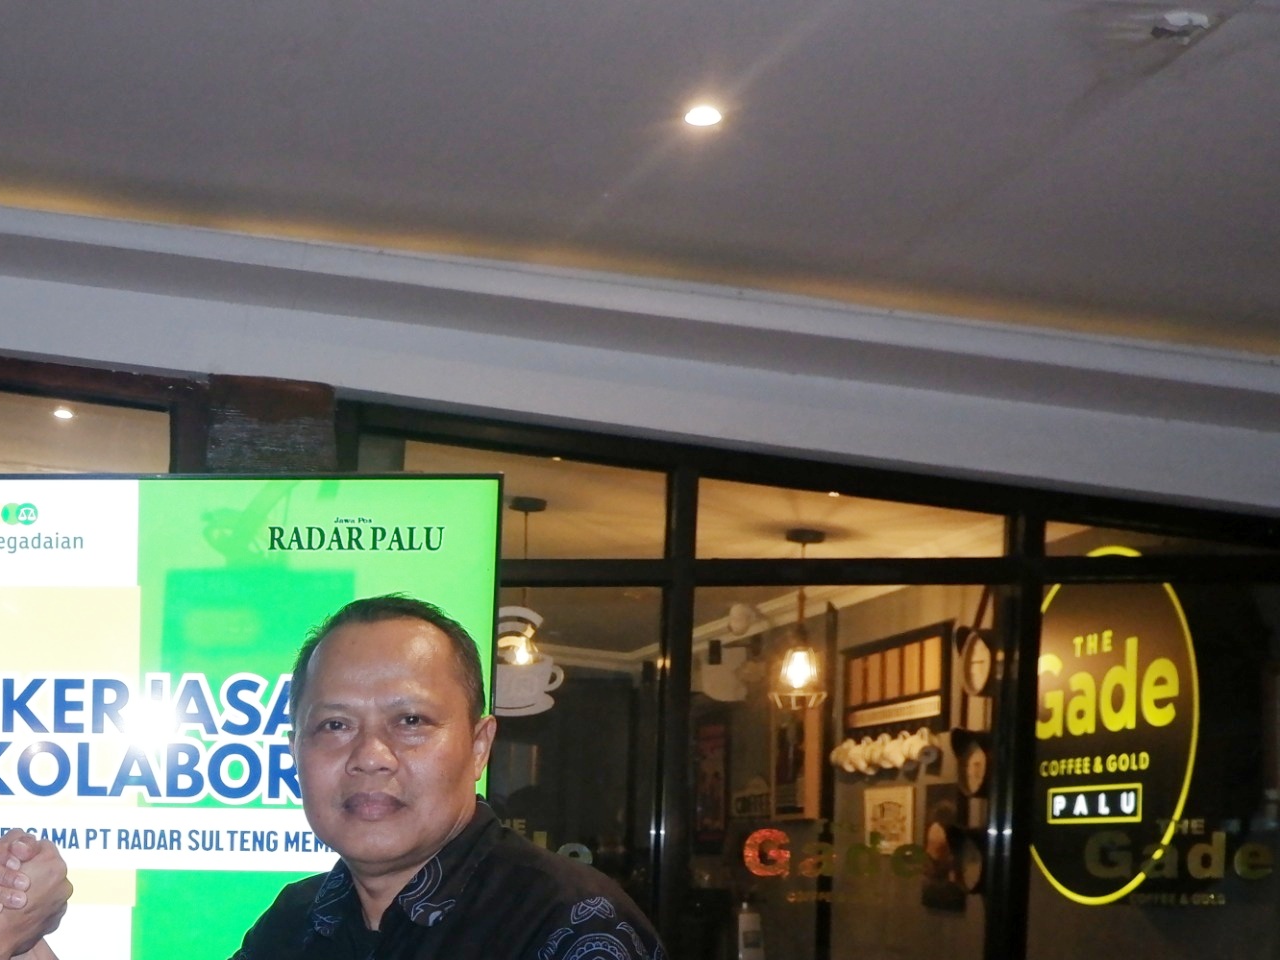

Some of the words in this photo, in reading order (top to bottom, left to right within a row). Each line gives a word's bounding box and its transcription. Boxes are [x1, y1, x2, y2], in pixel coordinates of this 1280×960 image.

[334, 516, 355, 524] Jawa
[268, 526, 365, 551] RADAR
[369, 526, 446, 551] PALU
[1073, 630, 1113, 658] THE
[1035, 636, 1180, 740] Gade
[1039, 756, 1091, 777] COFFEE
[1093, 756, 1103, 774] &
[1106, 752, 1150, 773] GOLD
[1052, 791, 1136, 817] PALU
[500, 818, 527, 835] HE
[85, 828, 111, 850] PT
[117, 829, 182, 851] RADAR
[188, 829, 278, 853] SULTENG
[1084, 830, 1274, 880] Gade
